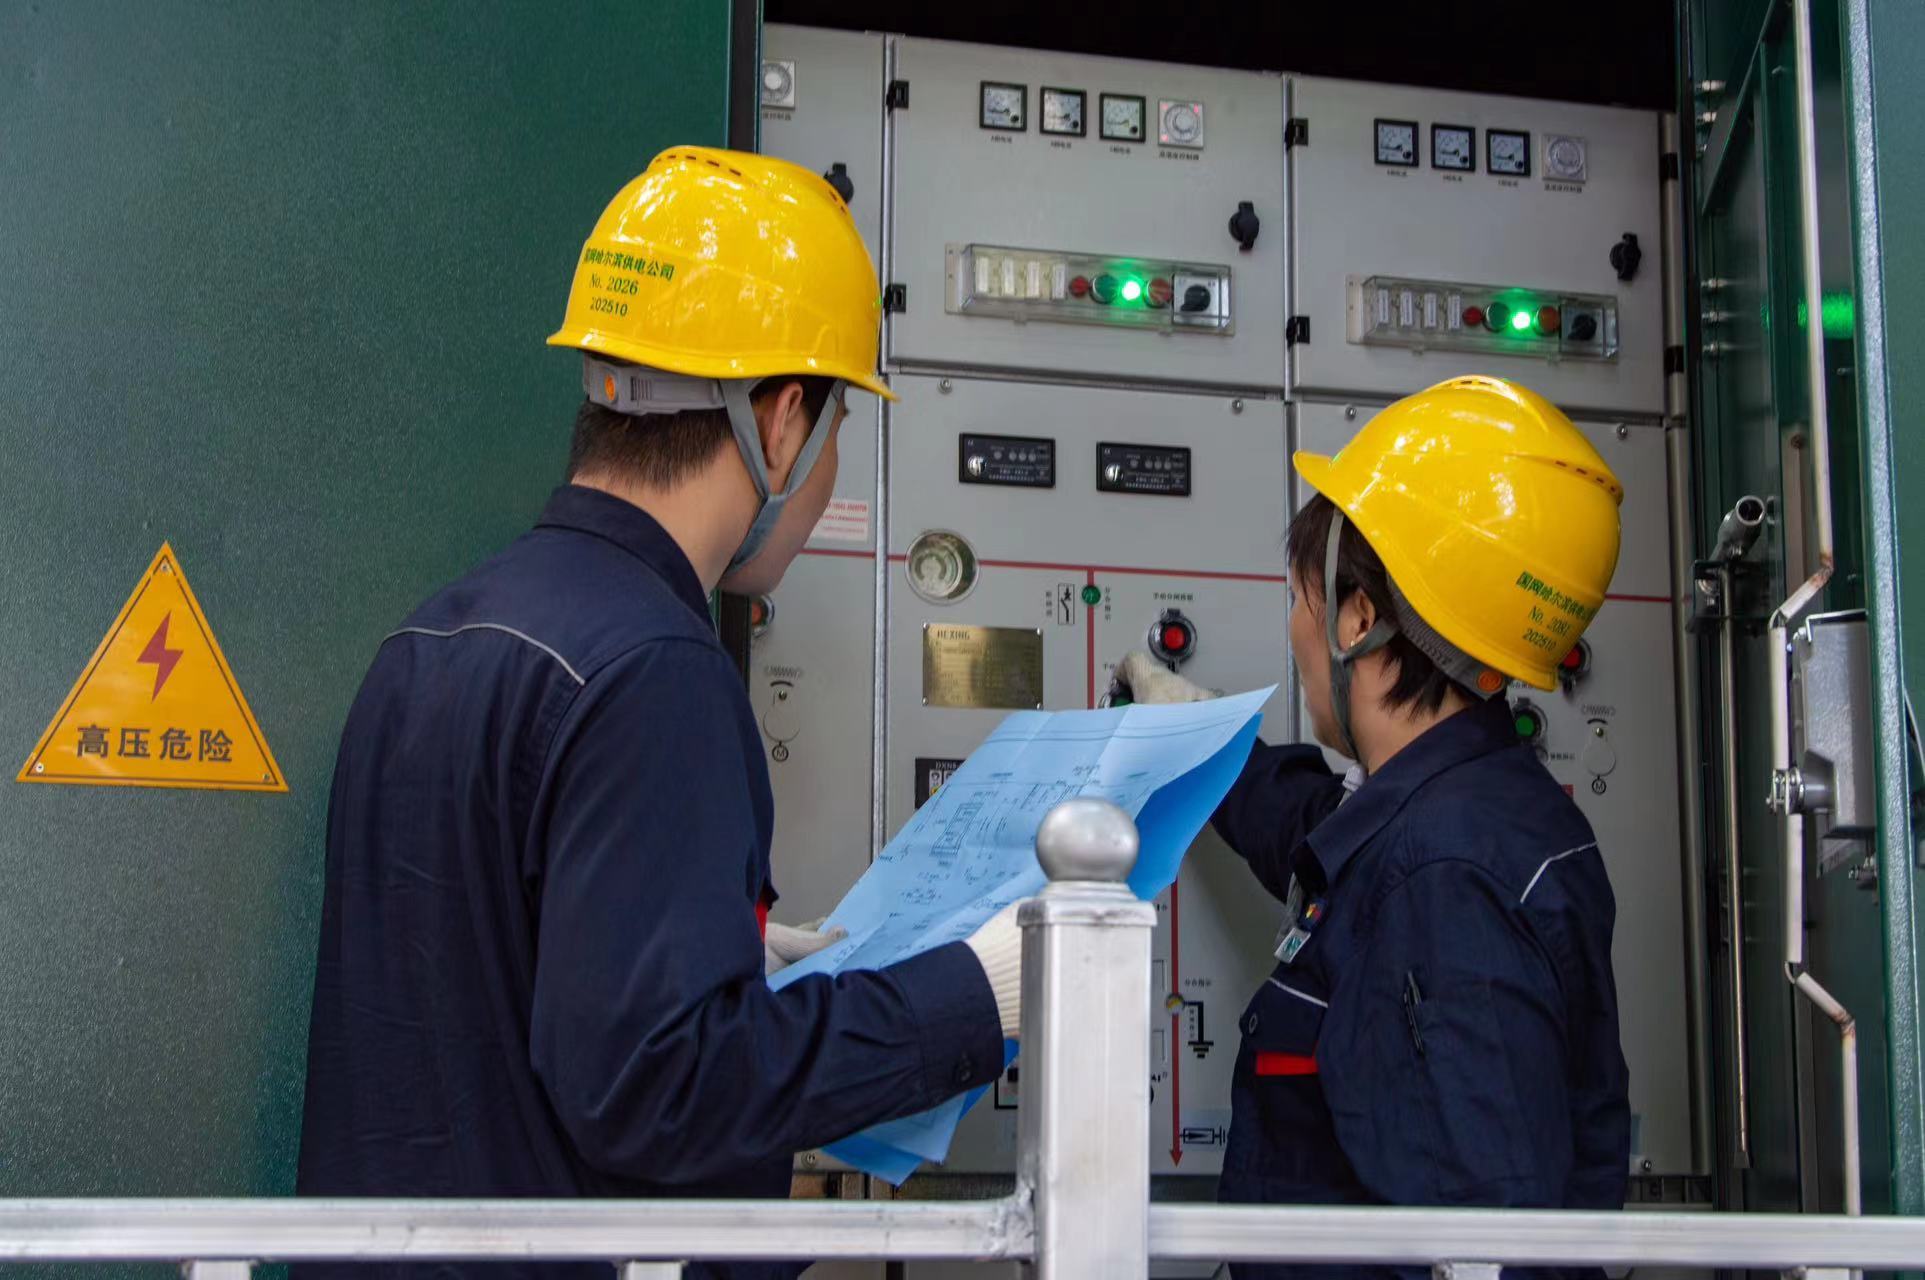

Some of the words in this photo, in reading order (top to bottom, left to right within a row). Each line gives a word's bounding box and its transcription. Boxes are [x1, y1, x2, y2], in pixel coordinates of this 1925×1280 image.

[606, 276, 640, 296] 2026
[590, 296, 628, 317] 202510
[76, 723, 233, 763] 高压危险
